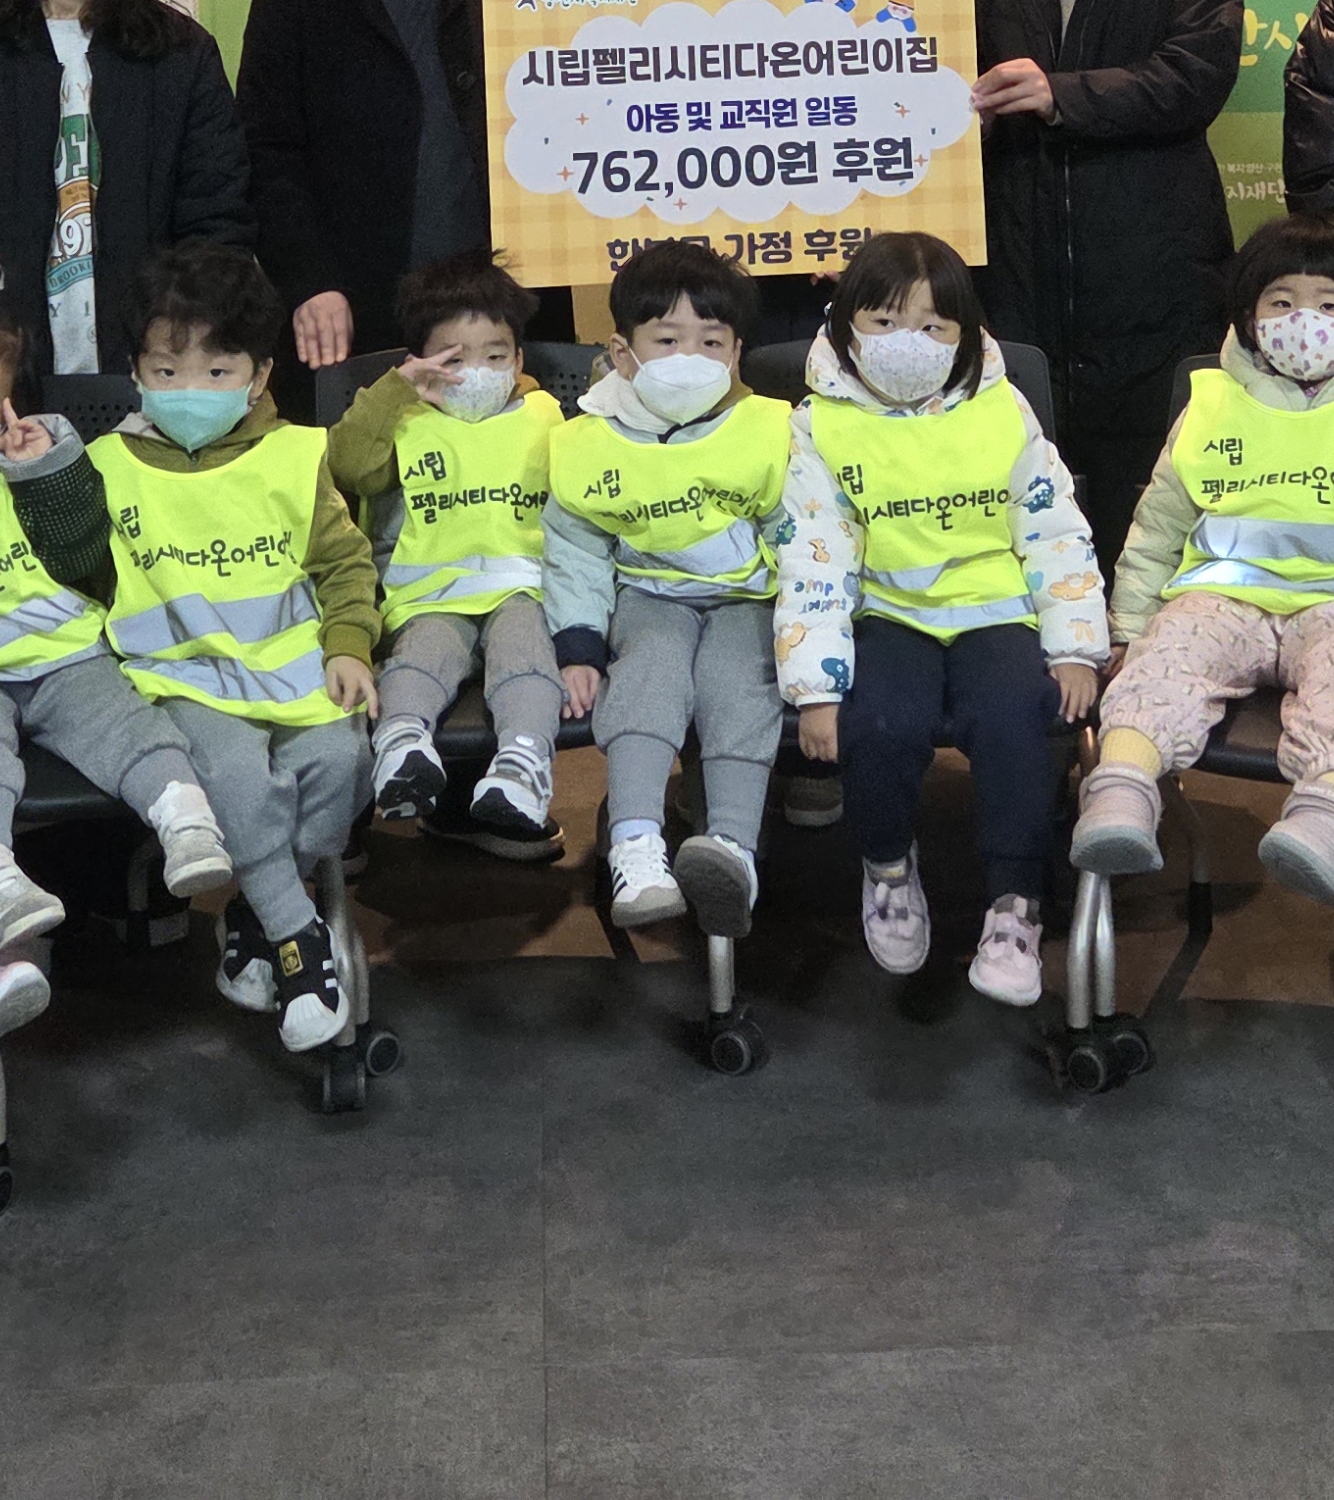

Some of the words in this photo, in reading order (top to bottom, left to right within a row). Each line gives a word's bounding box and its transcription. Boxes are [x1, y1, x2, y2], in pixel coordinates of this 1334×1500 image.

[522, 36, 939, 87] 시립펠리시티다온어린이집
[626, 103, 679, 133] 아동
[686, 102, 712, 131] 및
[719, 98, 798, 130] 교직원
[805, 96, 858, 127] 일동
[572, 140, 818, 198] 762,000원
[833, 137, 914, 184] 후원
[404, 451, 446, 481] 시립
[1203, 438, 1243, 466] 시립
[584, 468, 621, 498] 시립
